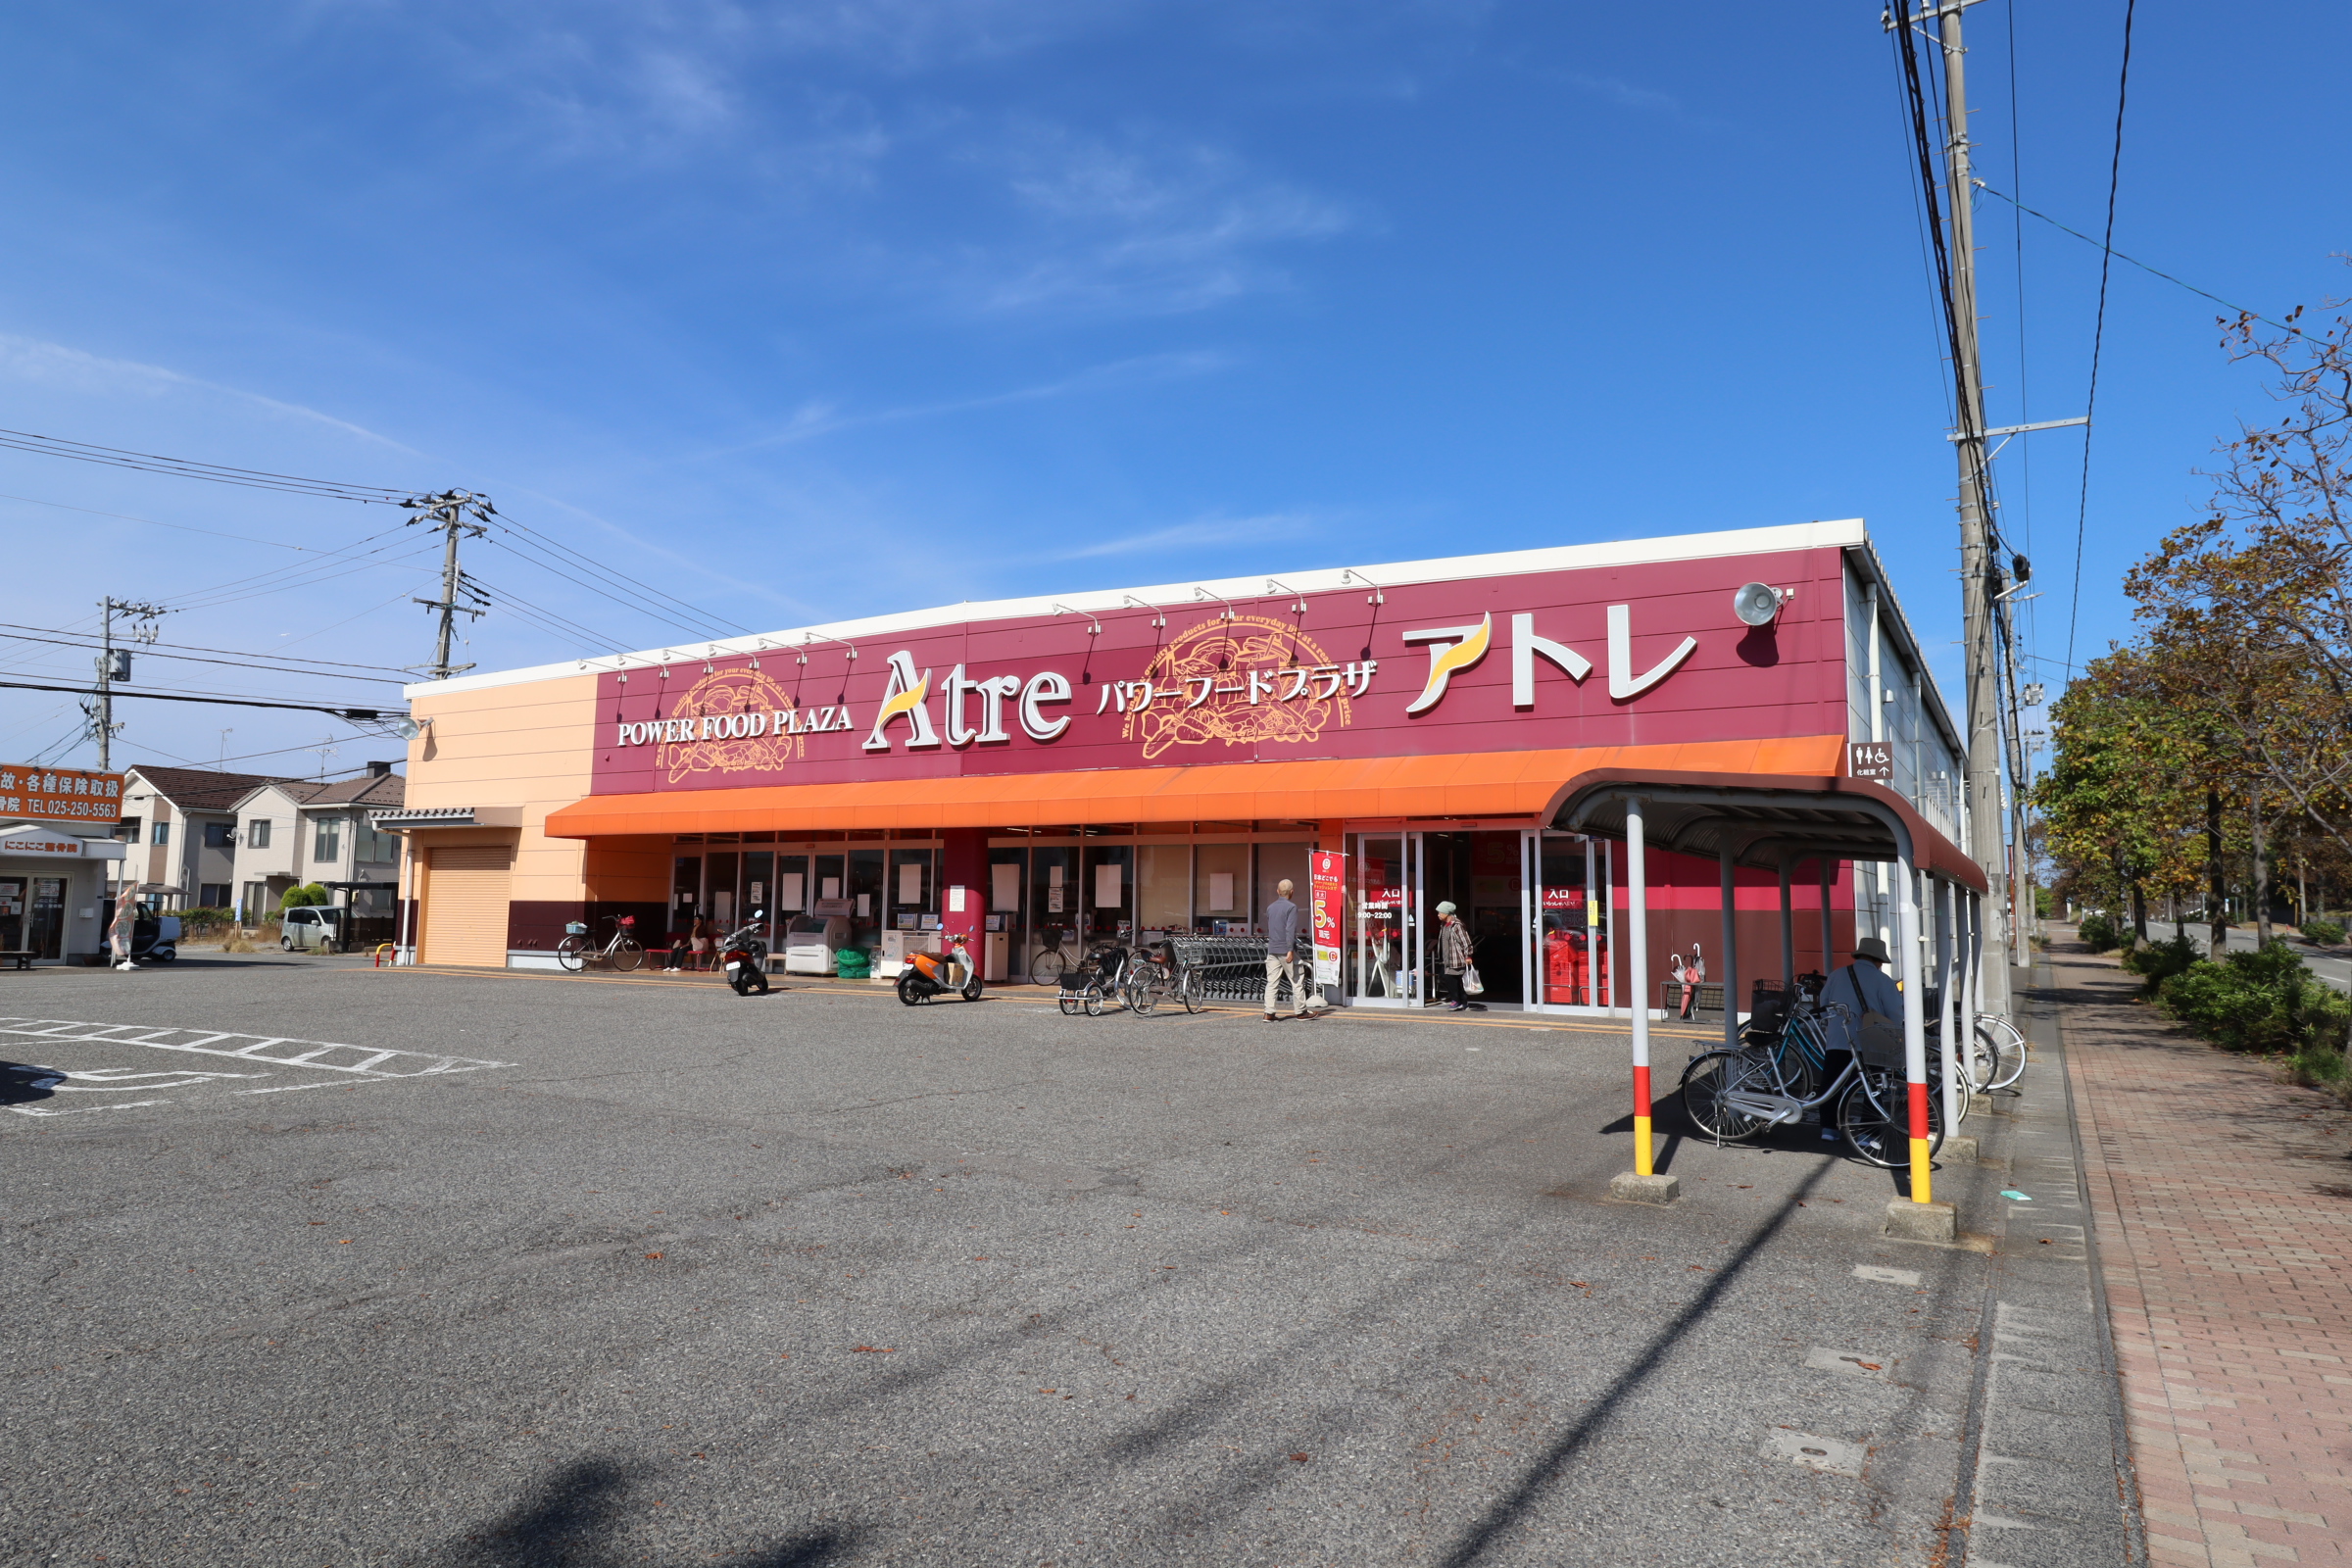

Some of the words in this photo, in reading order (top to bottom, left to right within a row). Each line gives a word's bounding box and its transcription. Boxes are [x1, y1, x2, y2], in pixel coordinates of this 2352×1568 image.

[1169, 622, 1206, 649] products
[1206, 616, 1222, 628] for
[1246, 614, 1287, 631] everyday
[1301, 634, 1312, 644] at
[1341, 697, 1352, 726] price
[1402, 605, 1697, 712] アトレ
[861, 650, 1072, 749] Atre
[1097, 660, 1378, 715] パワーフードプラザ
[617, 718, 696, 747] POWER
[701, 712, 766, 741] FOOD
[772, 705, 854, 735] PLAZA
[27, 798, 45, 813] TEL
[48, 800, 117, 817] 025-250-5563
[5, 841, 78, 854] にこにこ整骨院
[1381, 888, 1400, 899] 入口
[1548, 888, 1569, 900] 入口
